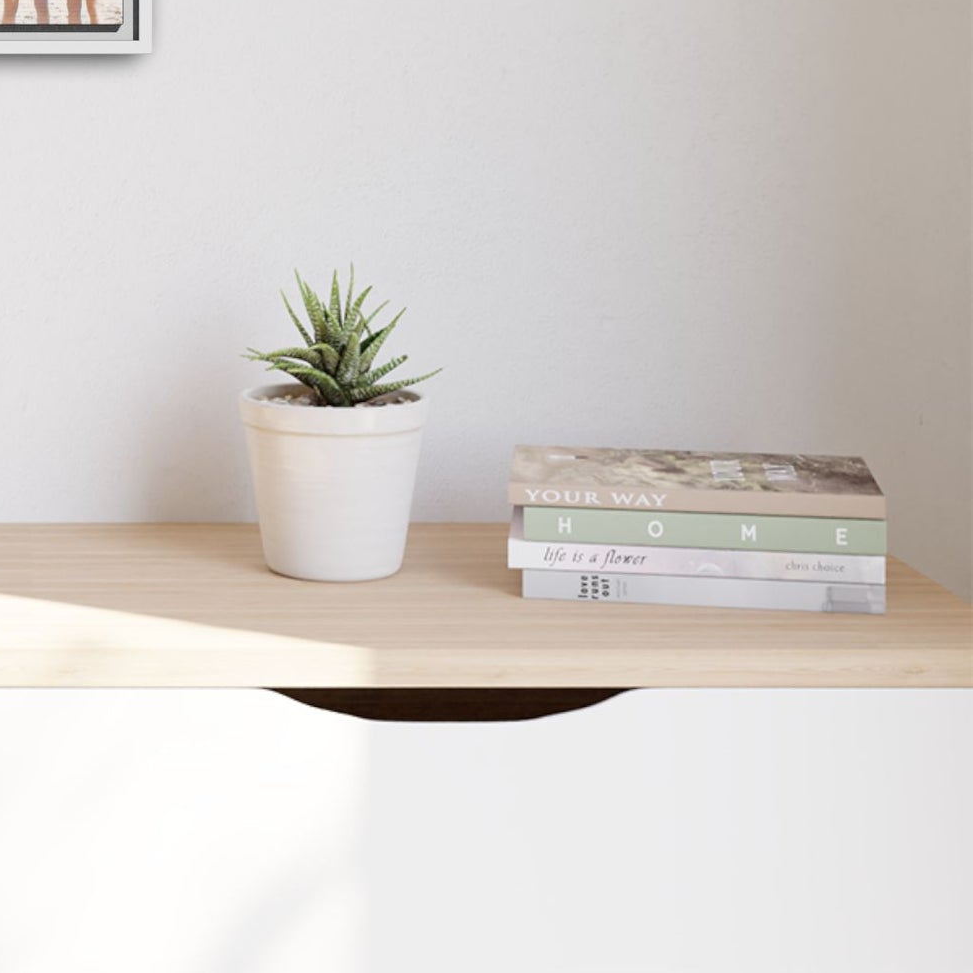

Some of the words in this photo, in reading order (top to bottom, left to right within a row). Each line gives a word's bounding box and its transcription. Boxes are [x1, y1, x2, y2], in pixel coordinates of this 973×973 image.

[525, 489, 601, 505] YOUR
[611, 492, 667, 507] WAY
[558, 516, 848, 546] HOME
[542, 546, 567, 567] life
[572, 550, 584, 564] is
[589, 553, 598, 564] a
[600, 548, 649, 569] flower
[785, 559, 810, 571] chris
[812, 561, 846, 573] choice
[577, 575, 589, 598] love
[591, 575, 599, 599] runs
[601, 578, 610, 597] out
